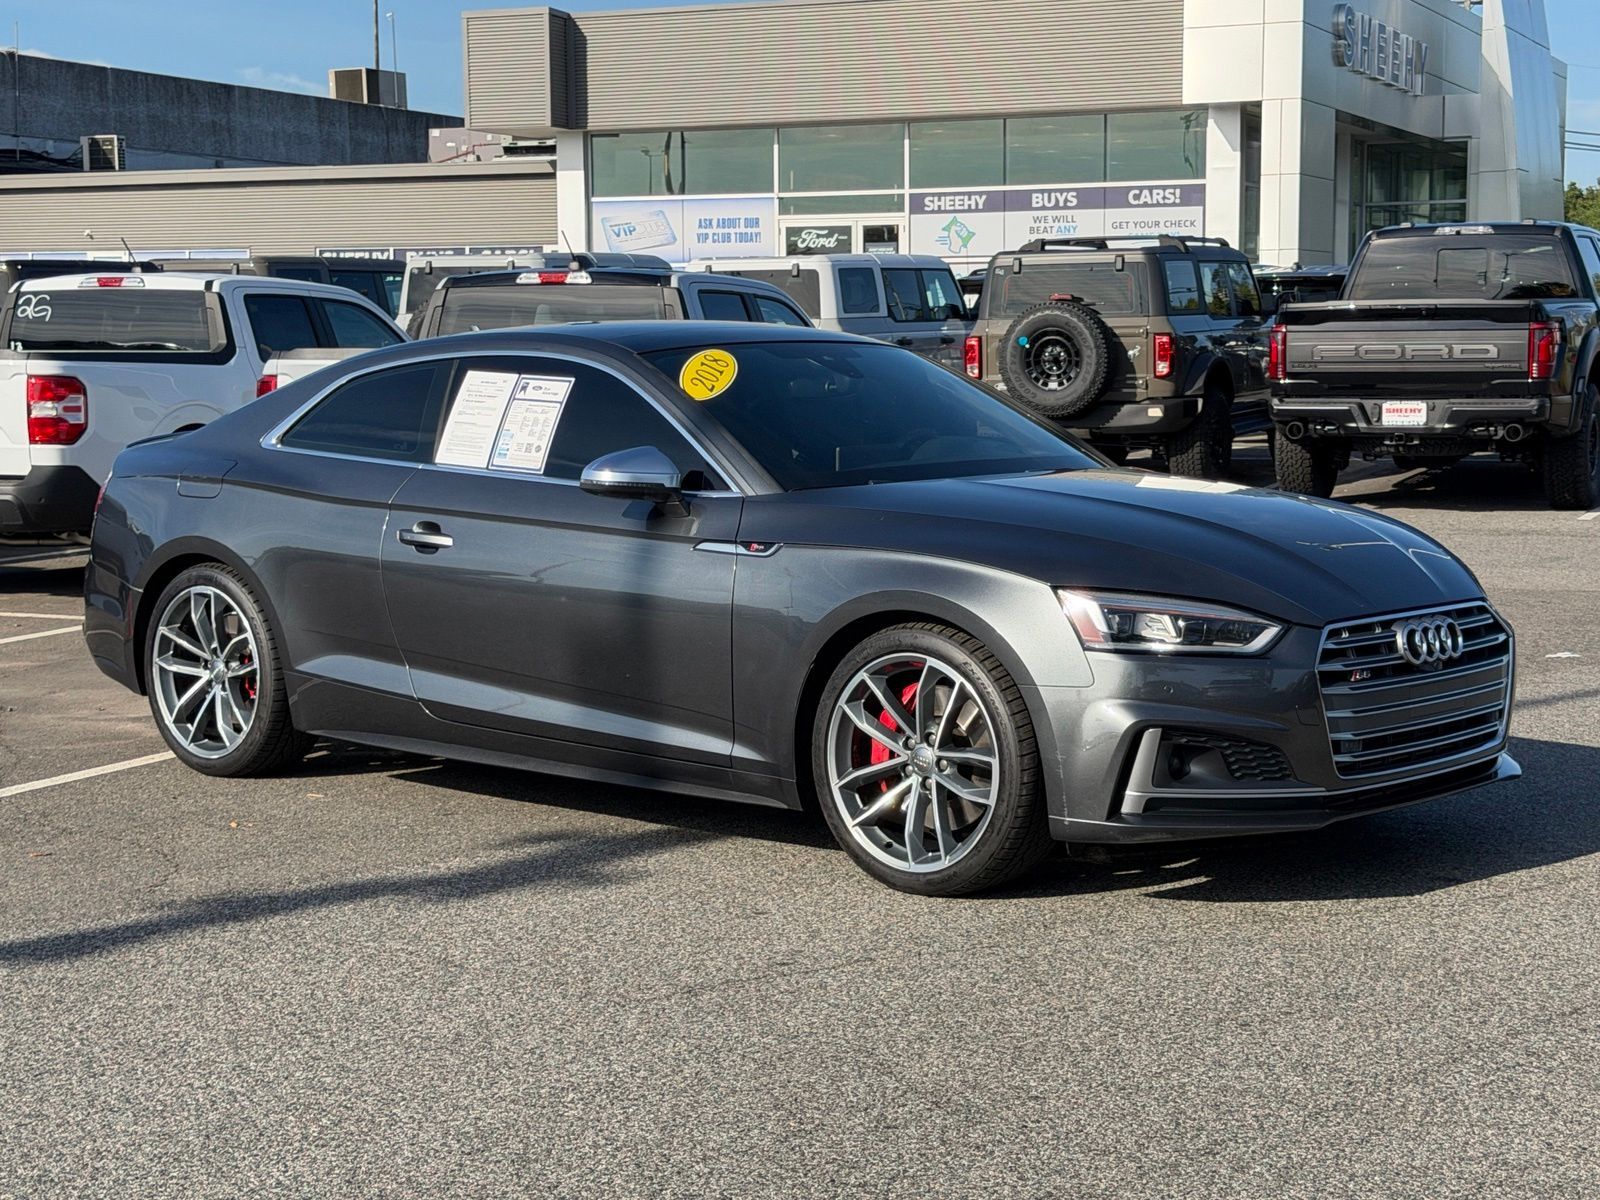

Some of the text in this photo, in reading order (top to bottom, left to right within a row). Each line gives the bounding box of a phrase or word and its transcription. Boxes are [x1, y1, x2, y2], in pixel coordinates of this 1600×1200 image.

[1332, 3, 1428, 96] SHEEHY
[923, 194, 987, 211] SHEEHY
[1031, 191, 1078, 208] BUYS
[1127, 188, 1181, 205] CARS!
[698, 217, 760, 229] ASK ABOUT OUR
[1032, 215, 1077, 224] WE WILL
[1111, 219, 1197, 230] GET YOUR CHECK
[611, 225, 637, 238] VIP
[696, 231, 762, 244] VIP CLUB TODAY!
[1029, 225, 1078, 235] BEAT ANY
[797, 229, 839, 248] Ford
[1312, 344, 1499, 360] FORD
[690, 354, 730, 393] 2018
